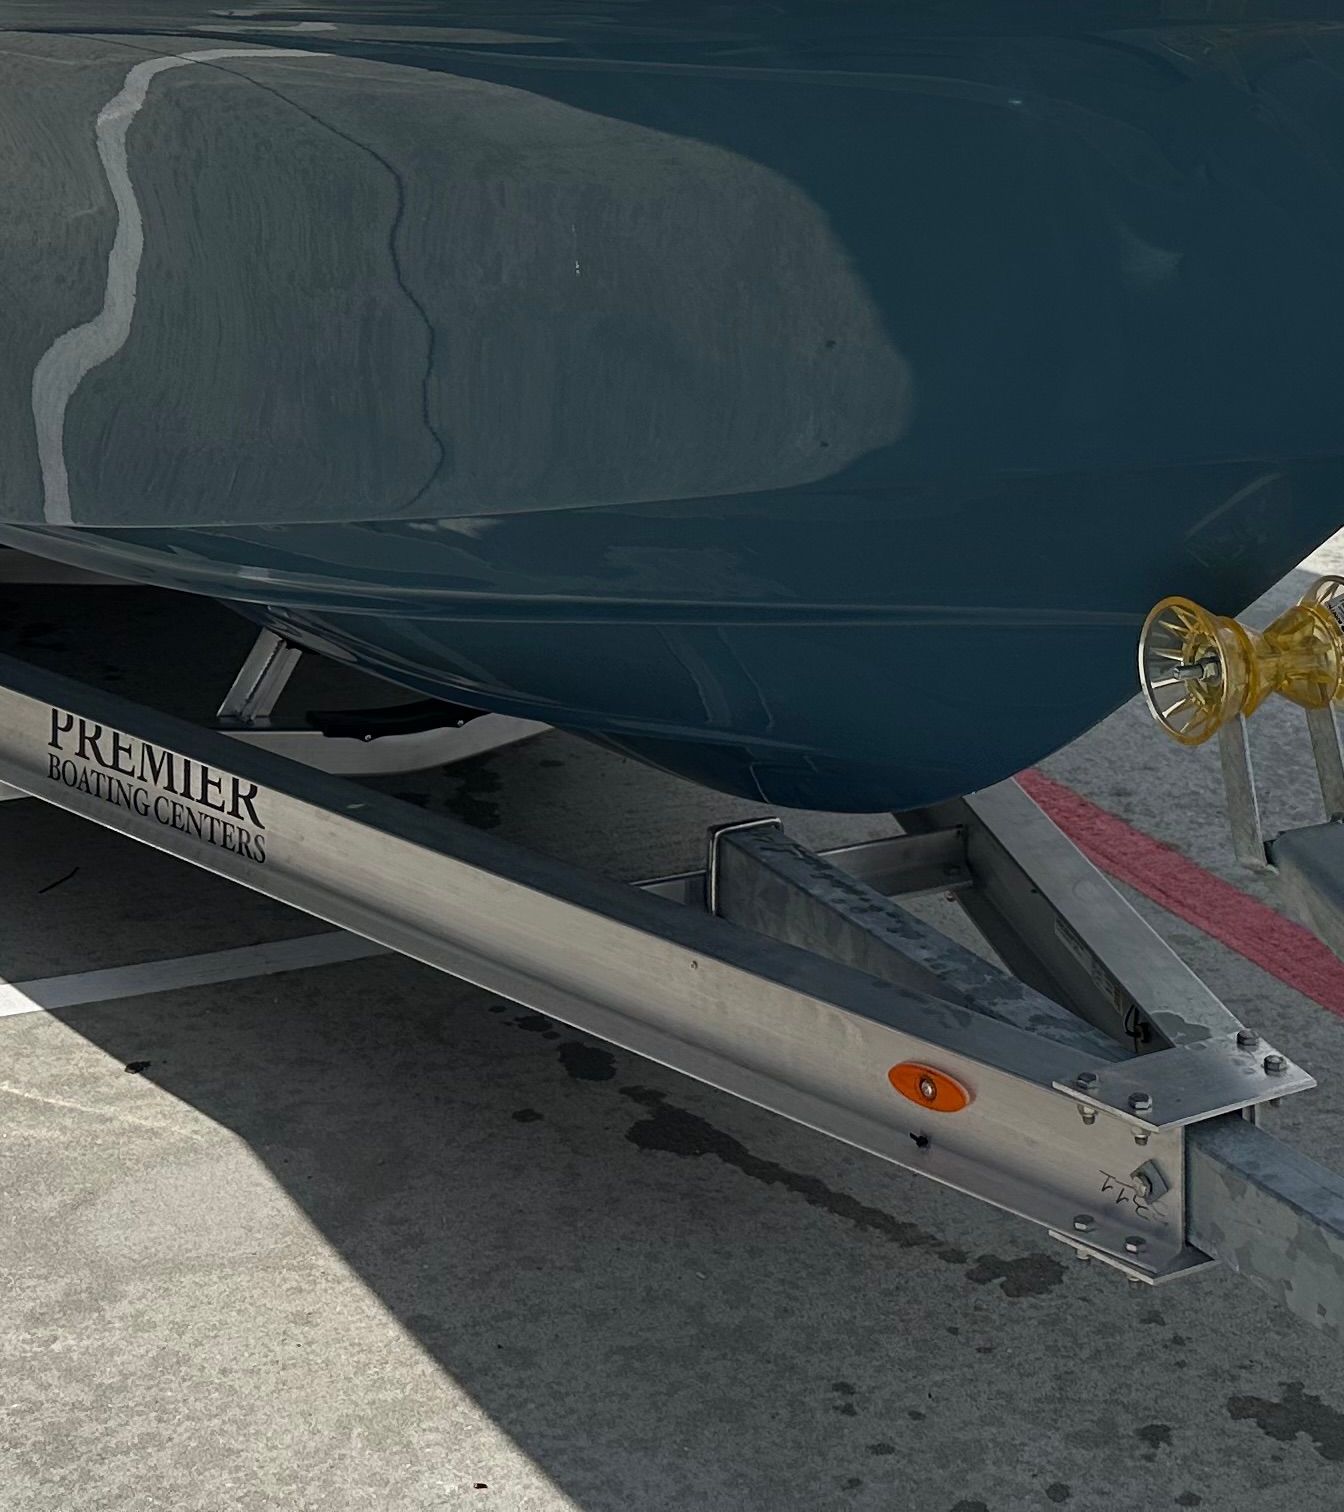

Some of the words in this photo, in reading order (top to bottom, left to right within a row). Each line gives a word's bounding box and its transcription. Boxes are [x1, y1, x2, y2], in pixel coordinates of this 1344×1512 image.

[47, 707, 266, 830] PREMIER
[47, 752, 151, 817] BOATING
[155, 795, 267, 864] CENTERS
